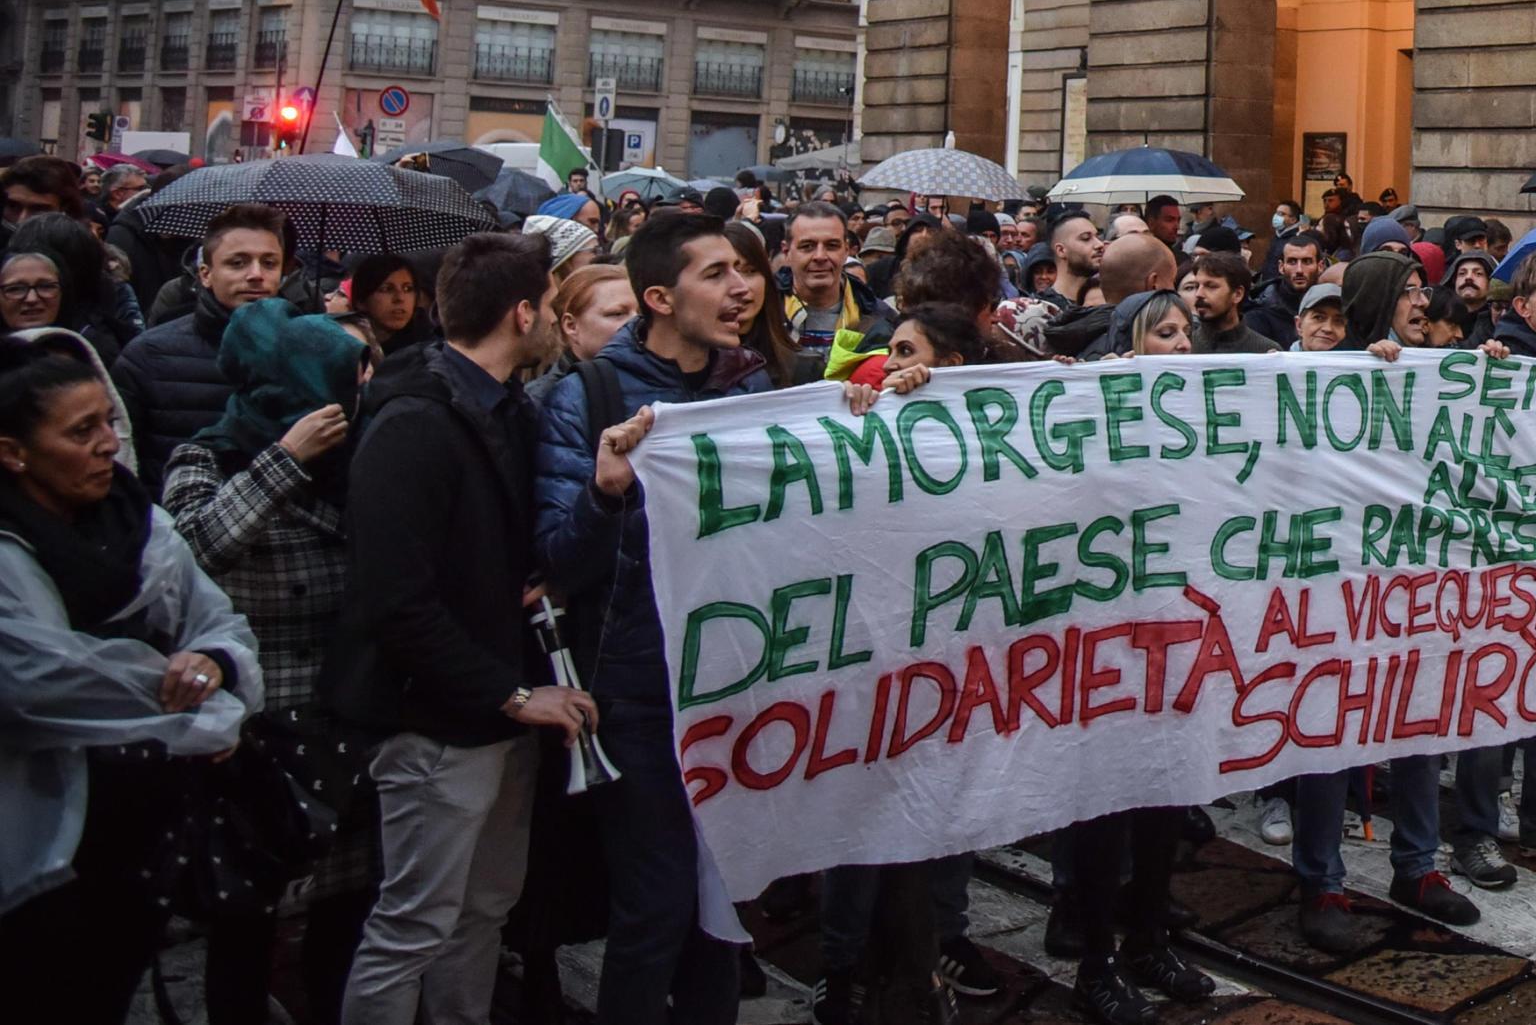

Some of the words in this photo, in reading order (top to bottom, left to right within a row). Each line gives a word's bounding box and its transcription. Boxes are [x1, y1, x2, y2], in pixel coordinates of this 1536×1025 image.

[691, 368, 1262, 540] LAMORGESE,
[1276, 370, 1415, 451] NON
[677, 573, 873, 711] DEL
[909, 502, 1189, 648] PAESE
[1210, 506, 1342, 580] CHE
[1255, 585, 1338, 653] AL
